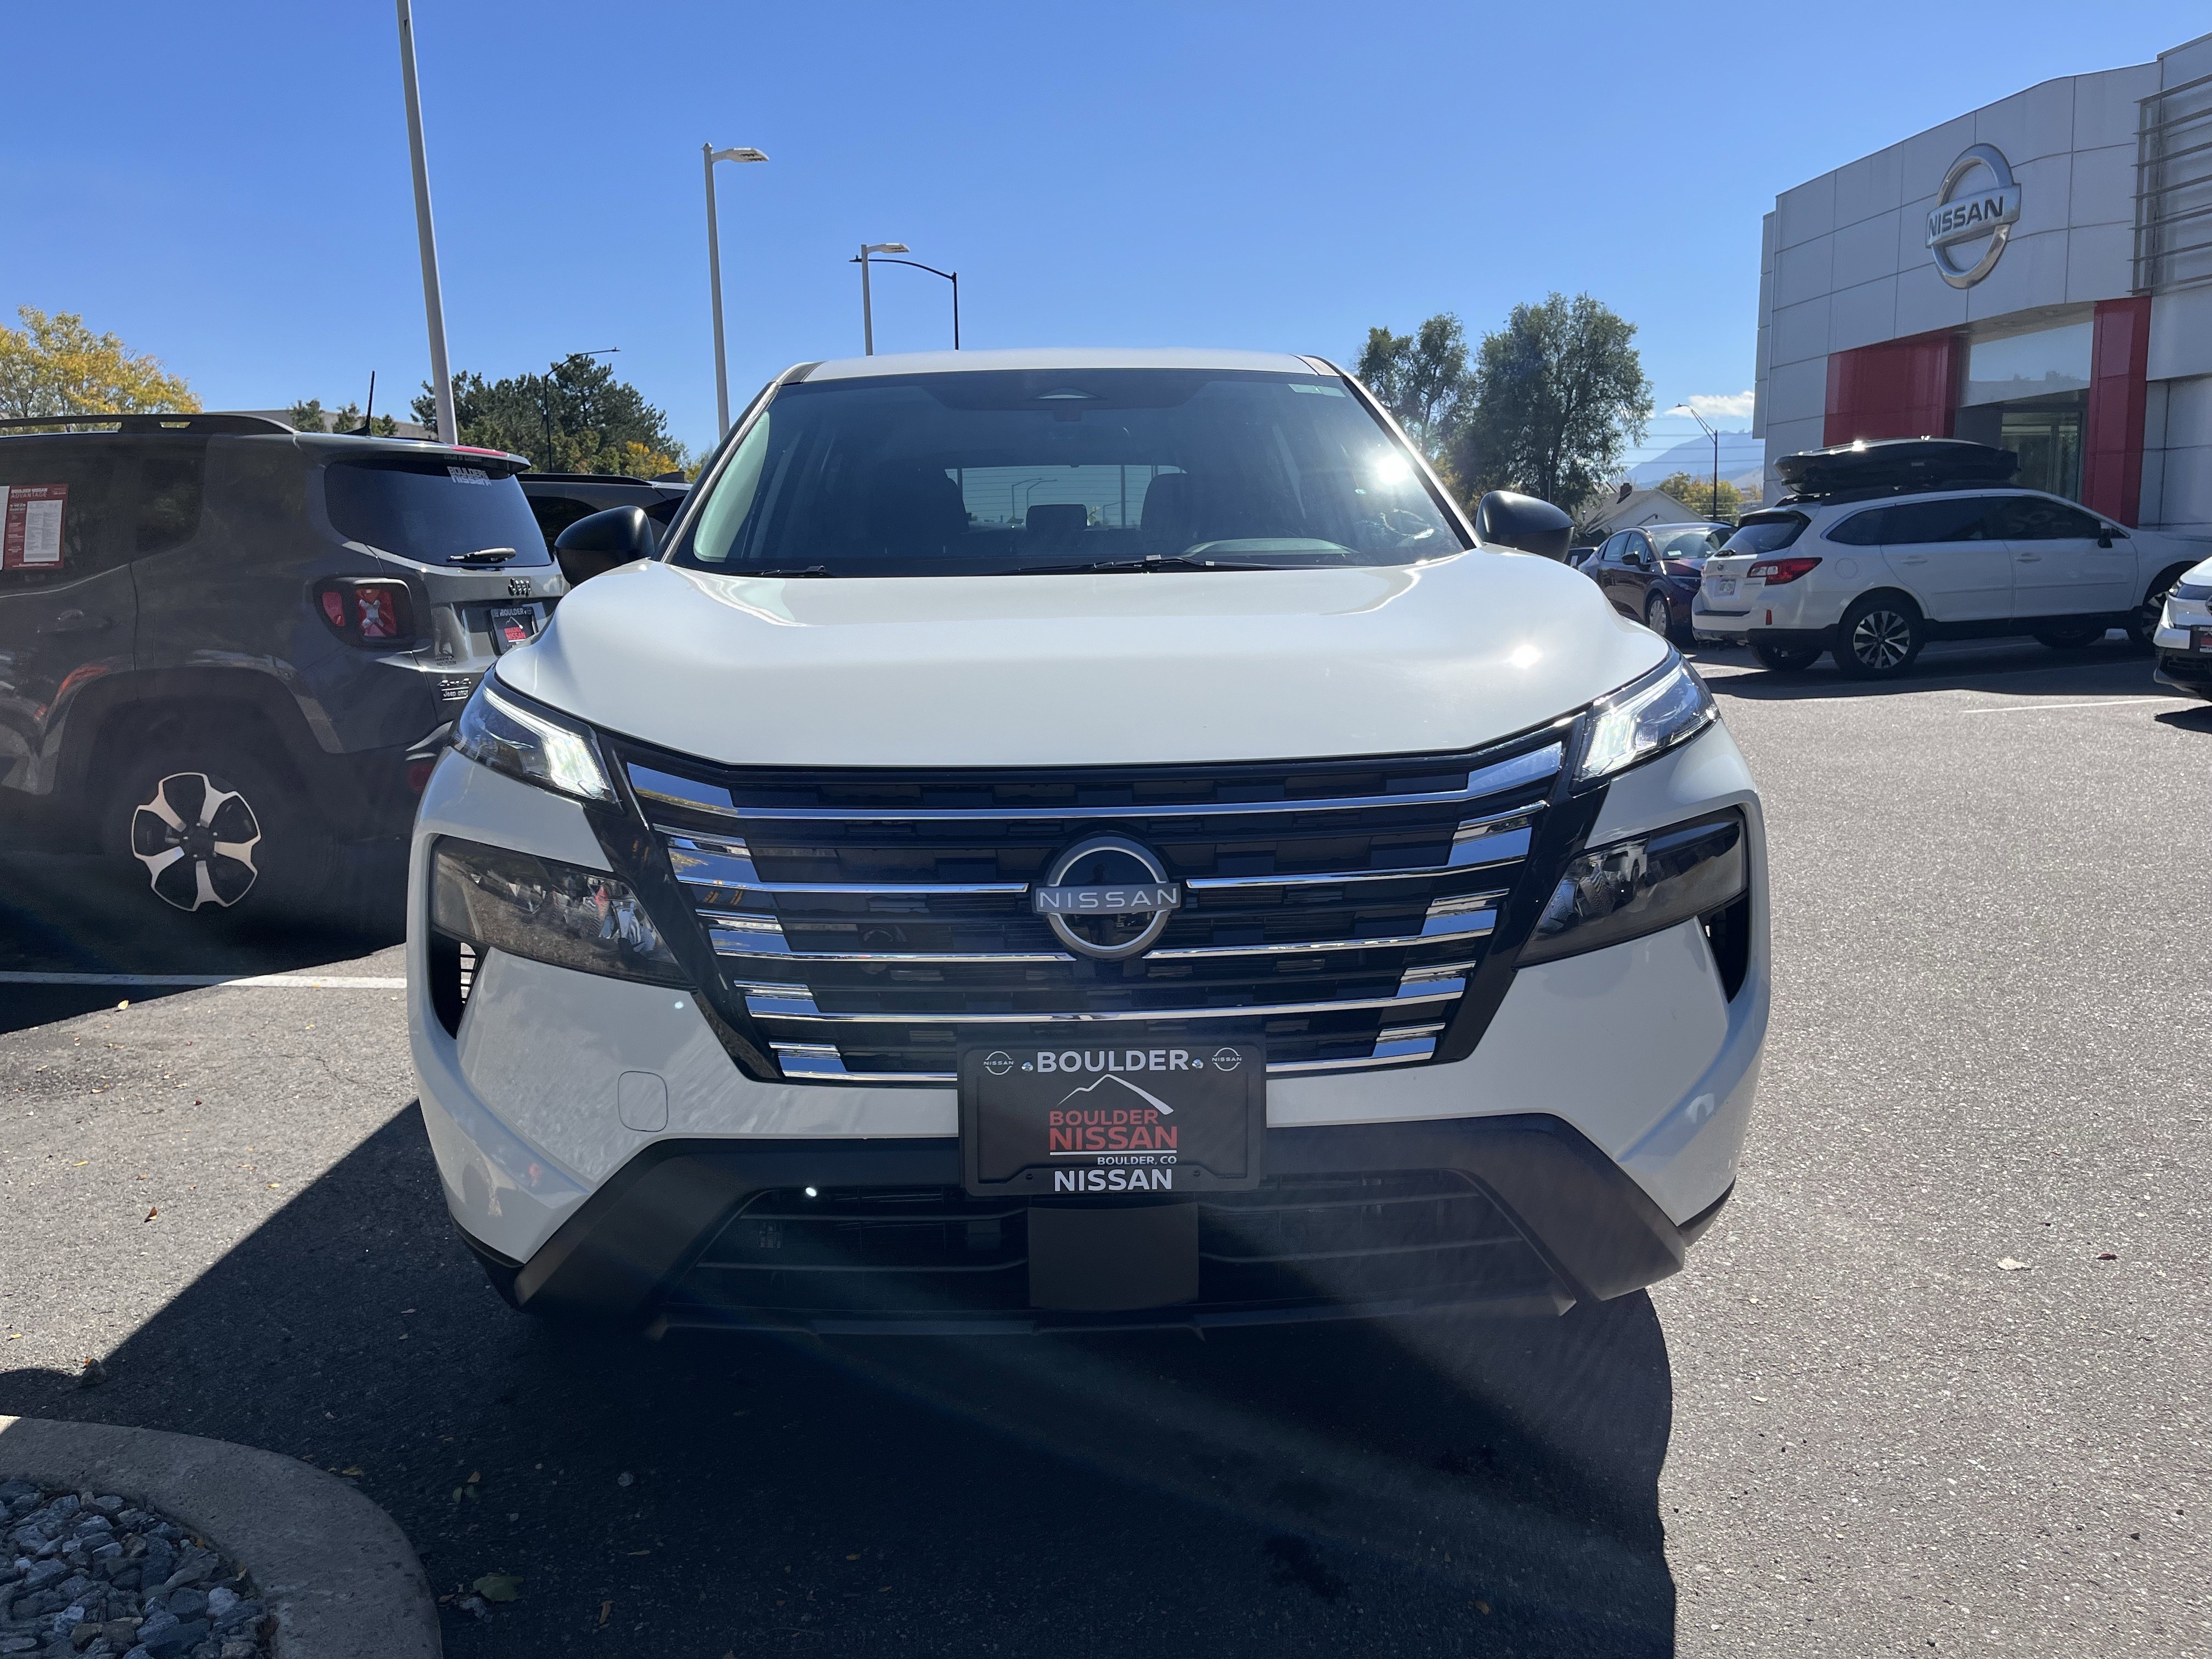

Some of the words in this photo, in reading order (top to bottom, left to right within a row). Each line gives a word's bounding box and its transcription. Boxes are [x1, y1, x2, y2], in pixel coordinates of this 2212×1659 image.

[1928, 196, 2004, 239] NISSAN
[1040, 888, 1177, 909] NISSAN
[1037, 1049, 1189, 1073] BOULDER
[1049, 1109, 1158, 1126] BOULDER
[1049, 1126, 1177, 1150] NISSAN
[1097, 1156, 1157, 1165] BOULDER,
[1160, 1155, 1177, 1164] CO
[1054, 1169, 1172, 1192] NISSAN
